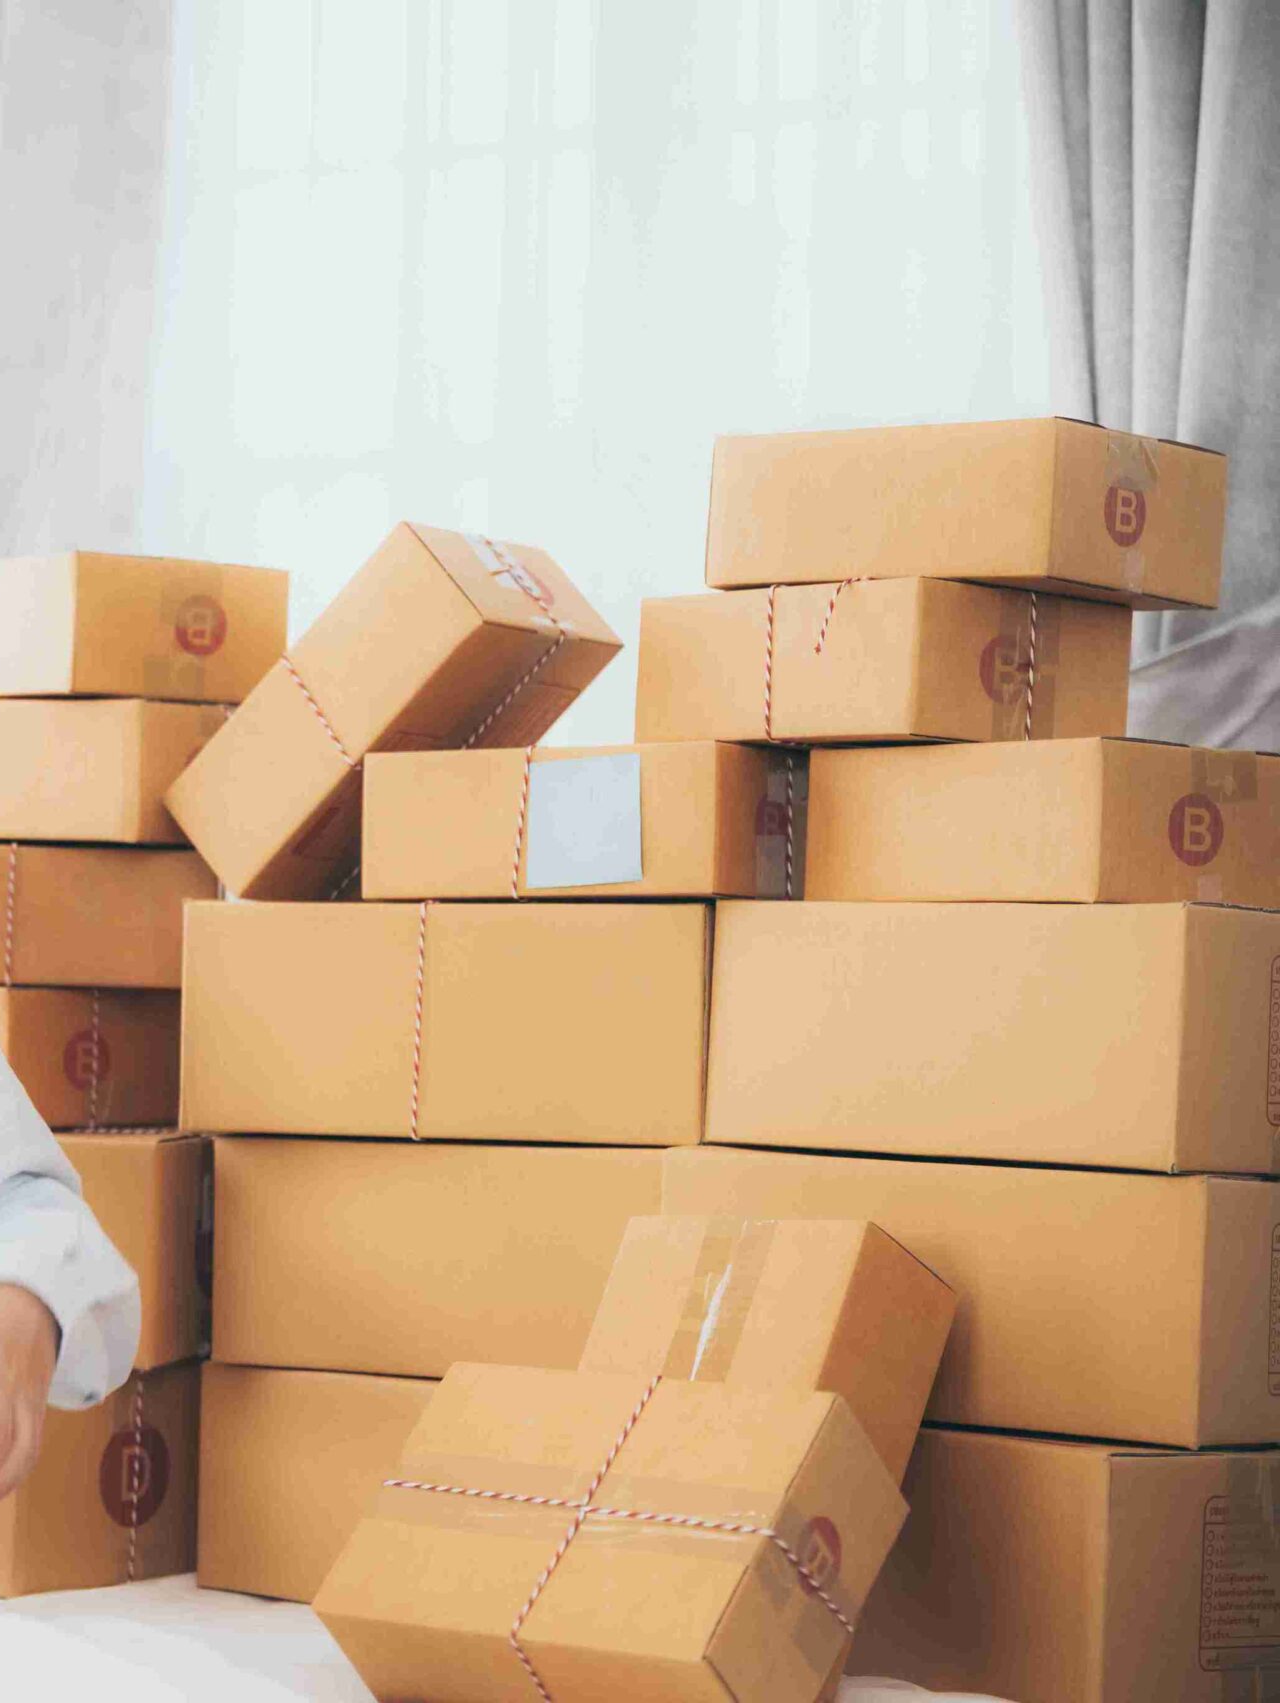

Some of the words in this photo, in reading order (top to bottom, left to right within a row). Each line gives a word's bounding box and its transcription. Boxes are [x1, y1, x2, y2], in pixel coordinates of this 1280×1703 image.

[1115, 488, 1137, 533] B
[187, 607, 211, 645] B
[1183, 807, 1211, 852] B
